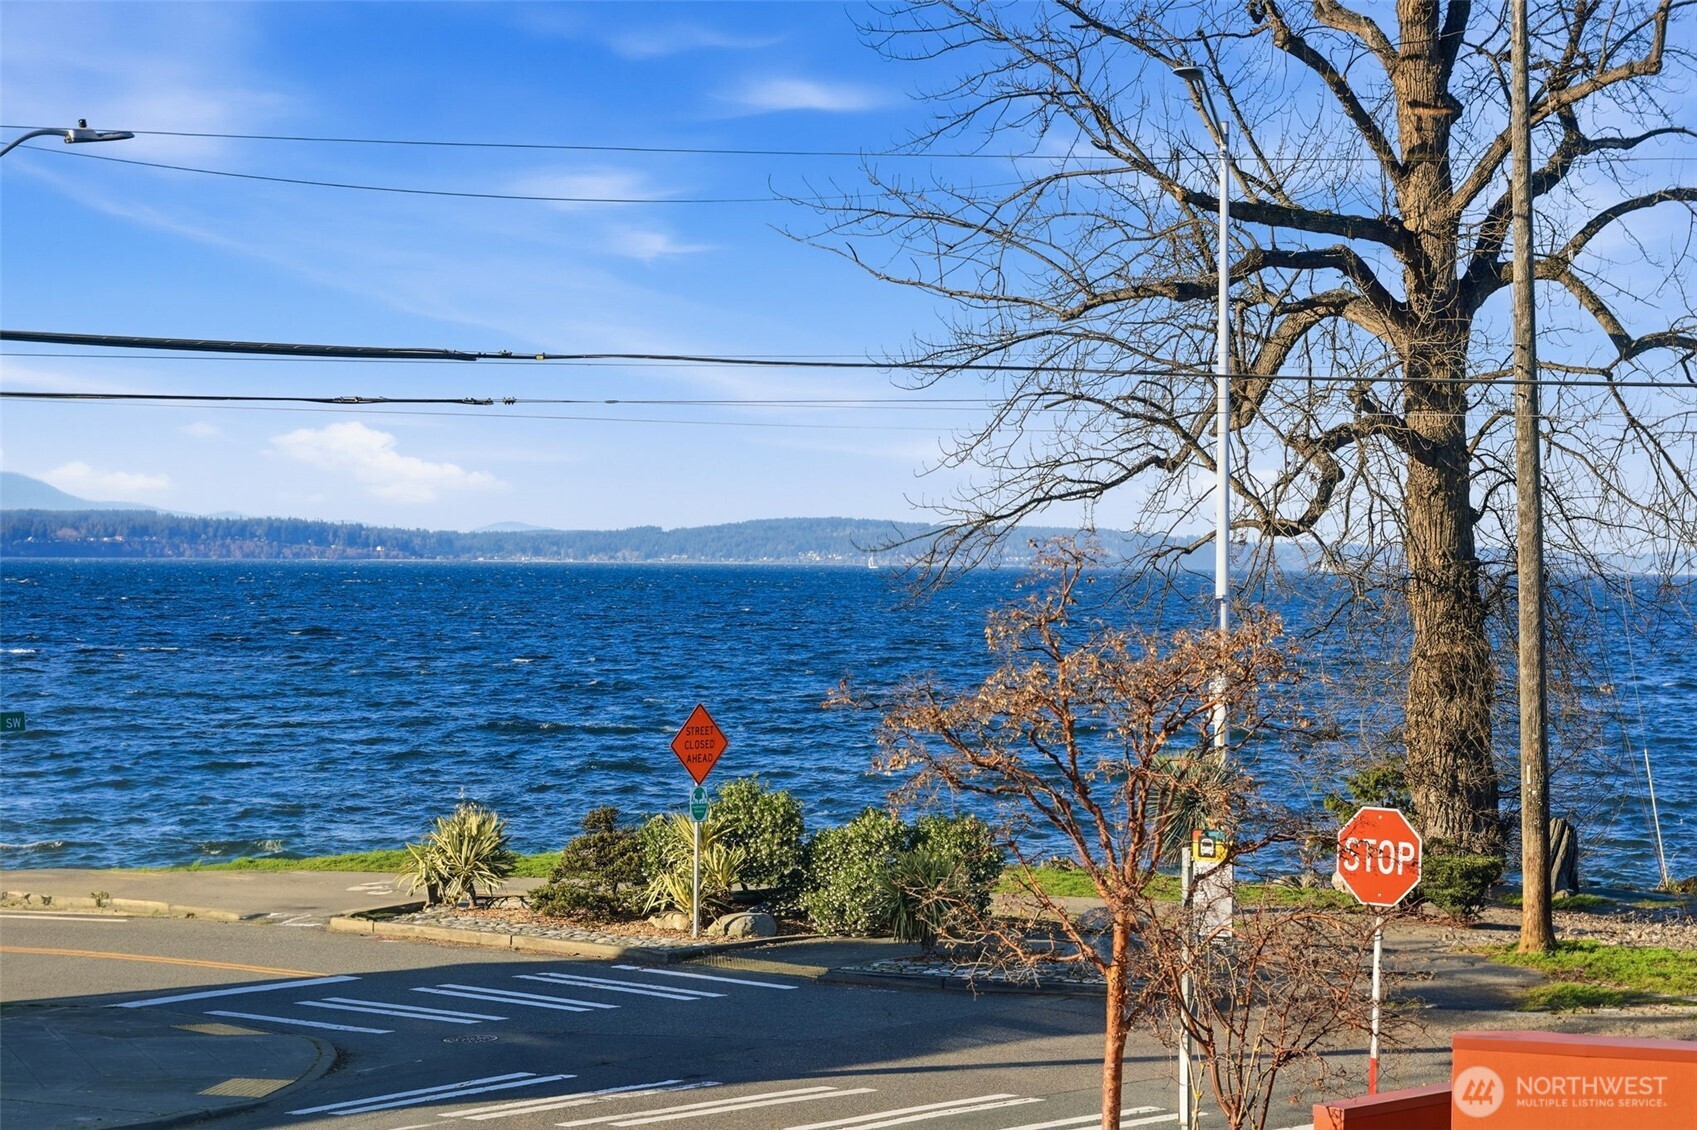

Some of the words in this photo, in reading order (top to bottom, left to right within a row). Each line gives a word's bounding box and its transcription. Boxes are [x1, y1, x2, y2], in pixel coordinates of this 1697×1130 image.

[6, 717, 21, 729] SW
[686, 725, 714, 736] STREET
[684, 740, 714, 750] CLOSED
[687, 753, 713, 763] AHEAD
[1343, 837, 1415, 875] STOP
